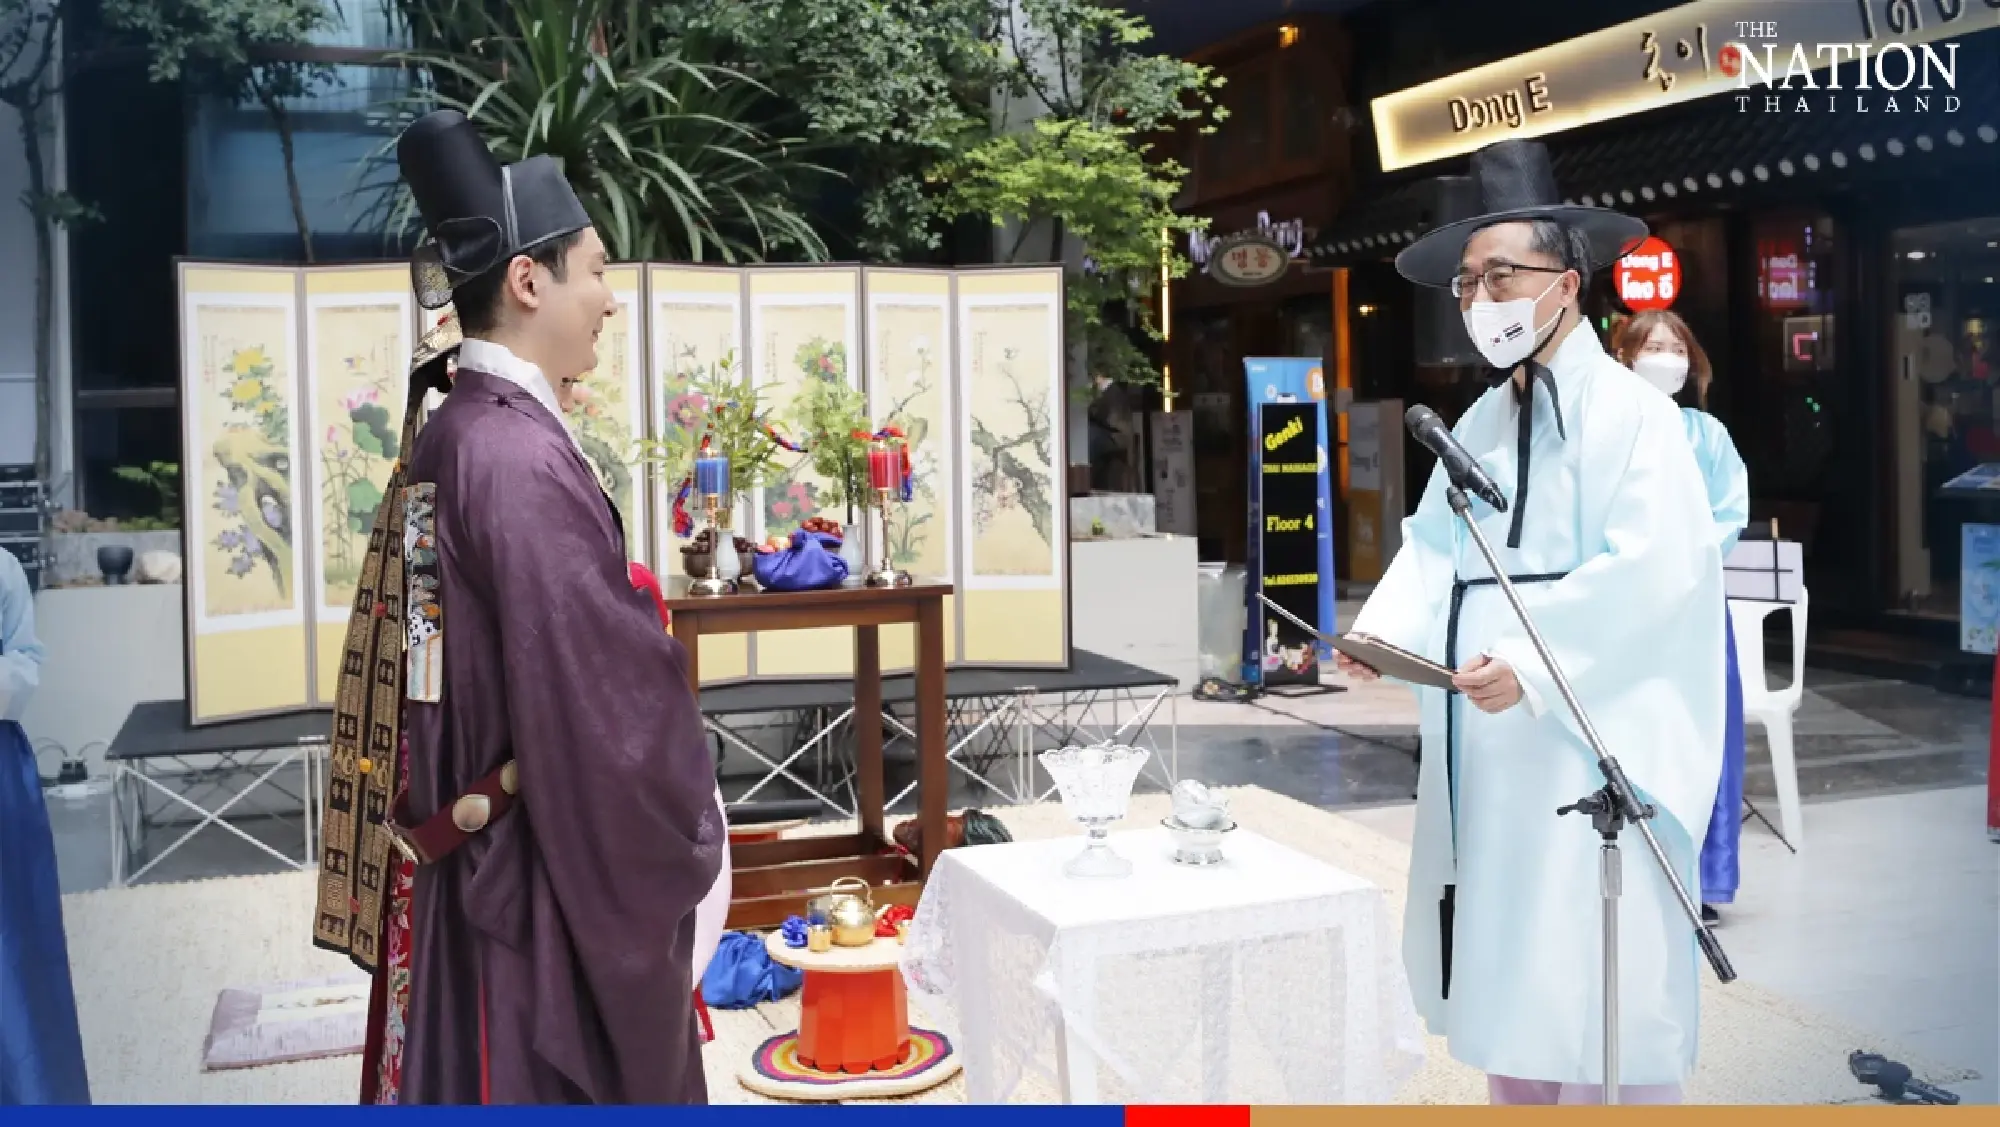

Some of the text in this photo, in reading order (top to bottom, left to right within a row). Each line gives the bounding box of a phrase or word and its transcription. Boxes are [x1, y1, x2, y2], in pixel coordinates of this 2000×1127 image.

[1448, 71, 1553, 134] Dong E
[1621, 250, 1673, 272] Dong E
[1265, 415, 1303, 450] Genki
[1266, 512, 1315, 532] Floor 4
